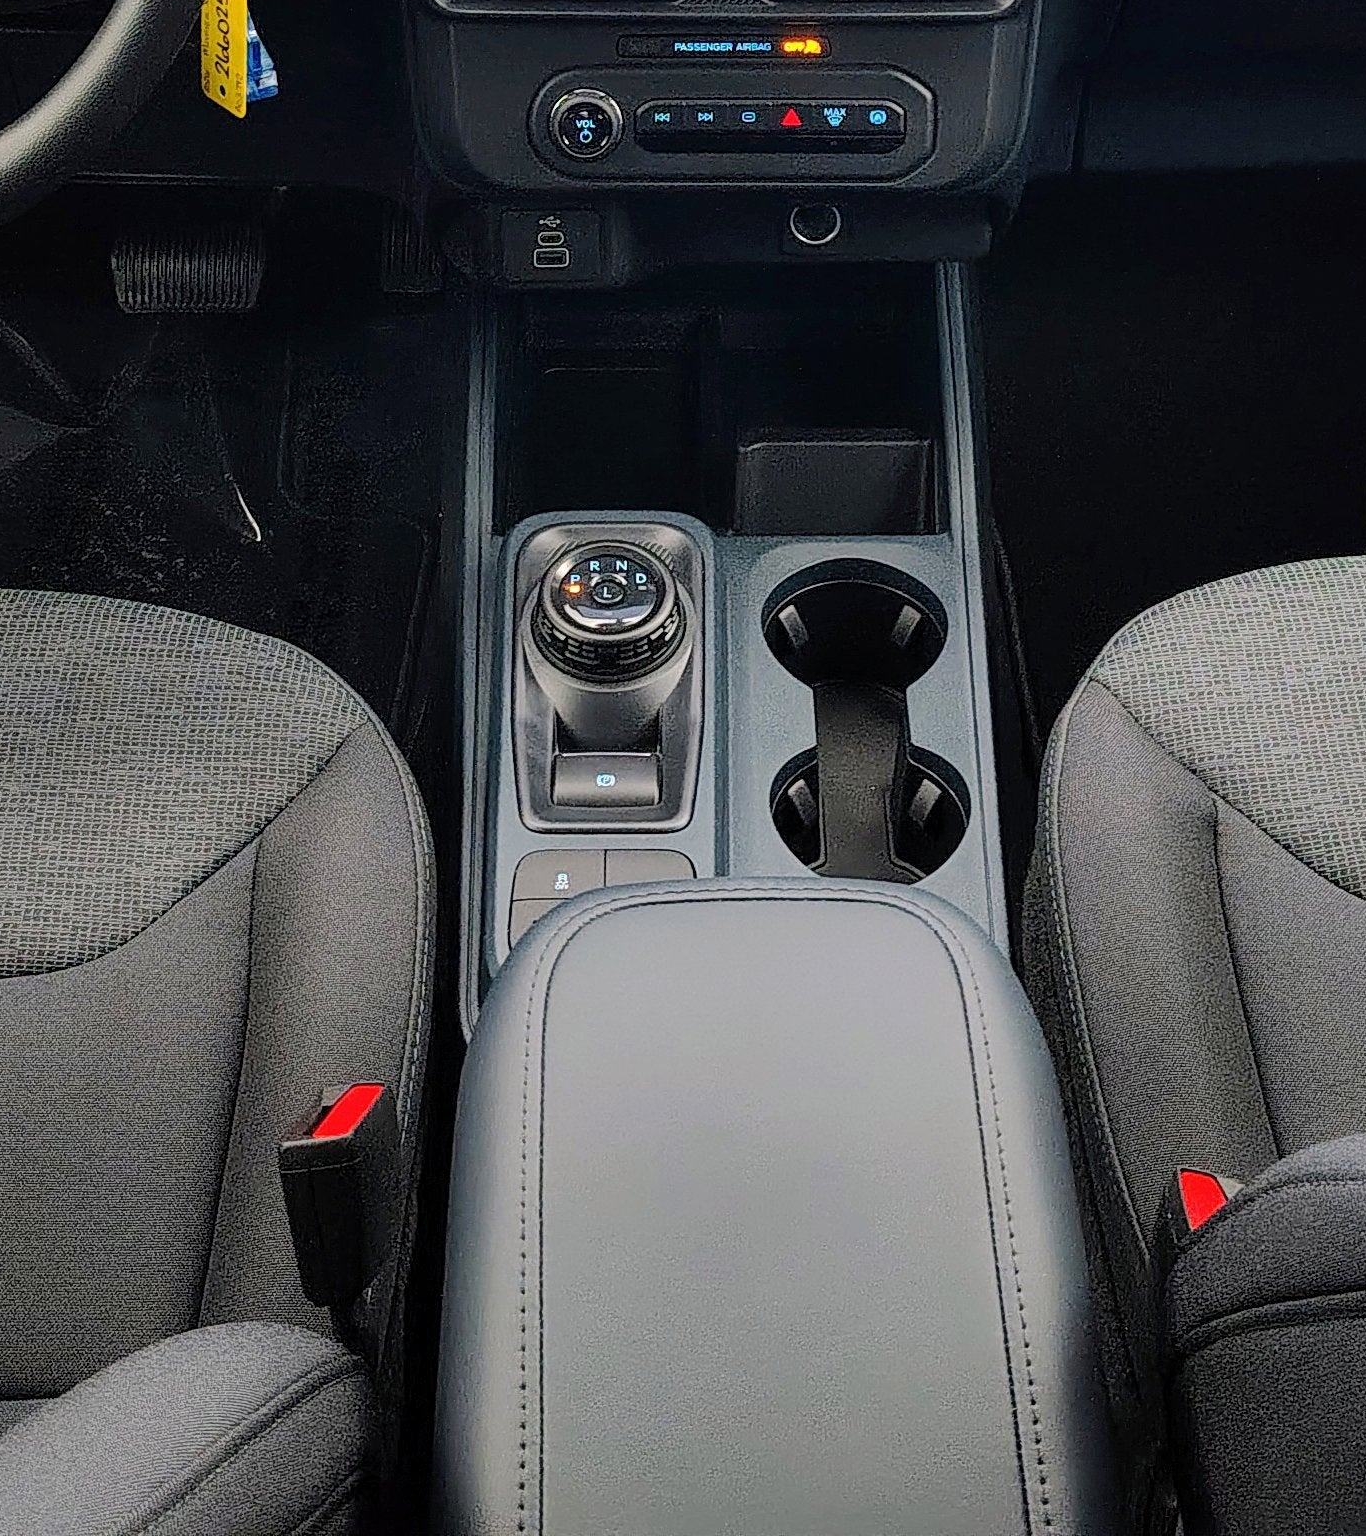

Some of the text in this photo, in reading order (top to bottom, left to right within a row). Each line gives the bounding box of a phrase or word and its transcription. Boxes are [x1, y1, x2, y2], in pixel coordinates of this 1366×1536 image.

[673, 42, 733, 52] PASSENGER
[735, 42, 772, 52] AIRBAG
[823, 107, 847, 117] MAX
[575, 119, 596, 129] VOL
[589, 560, 601, 571] R
[615, 559, 628, 571] N
[569, 574, 581, 585] P
[635, 572, 648, 584] D
[603, 586, 613, 598] L
